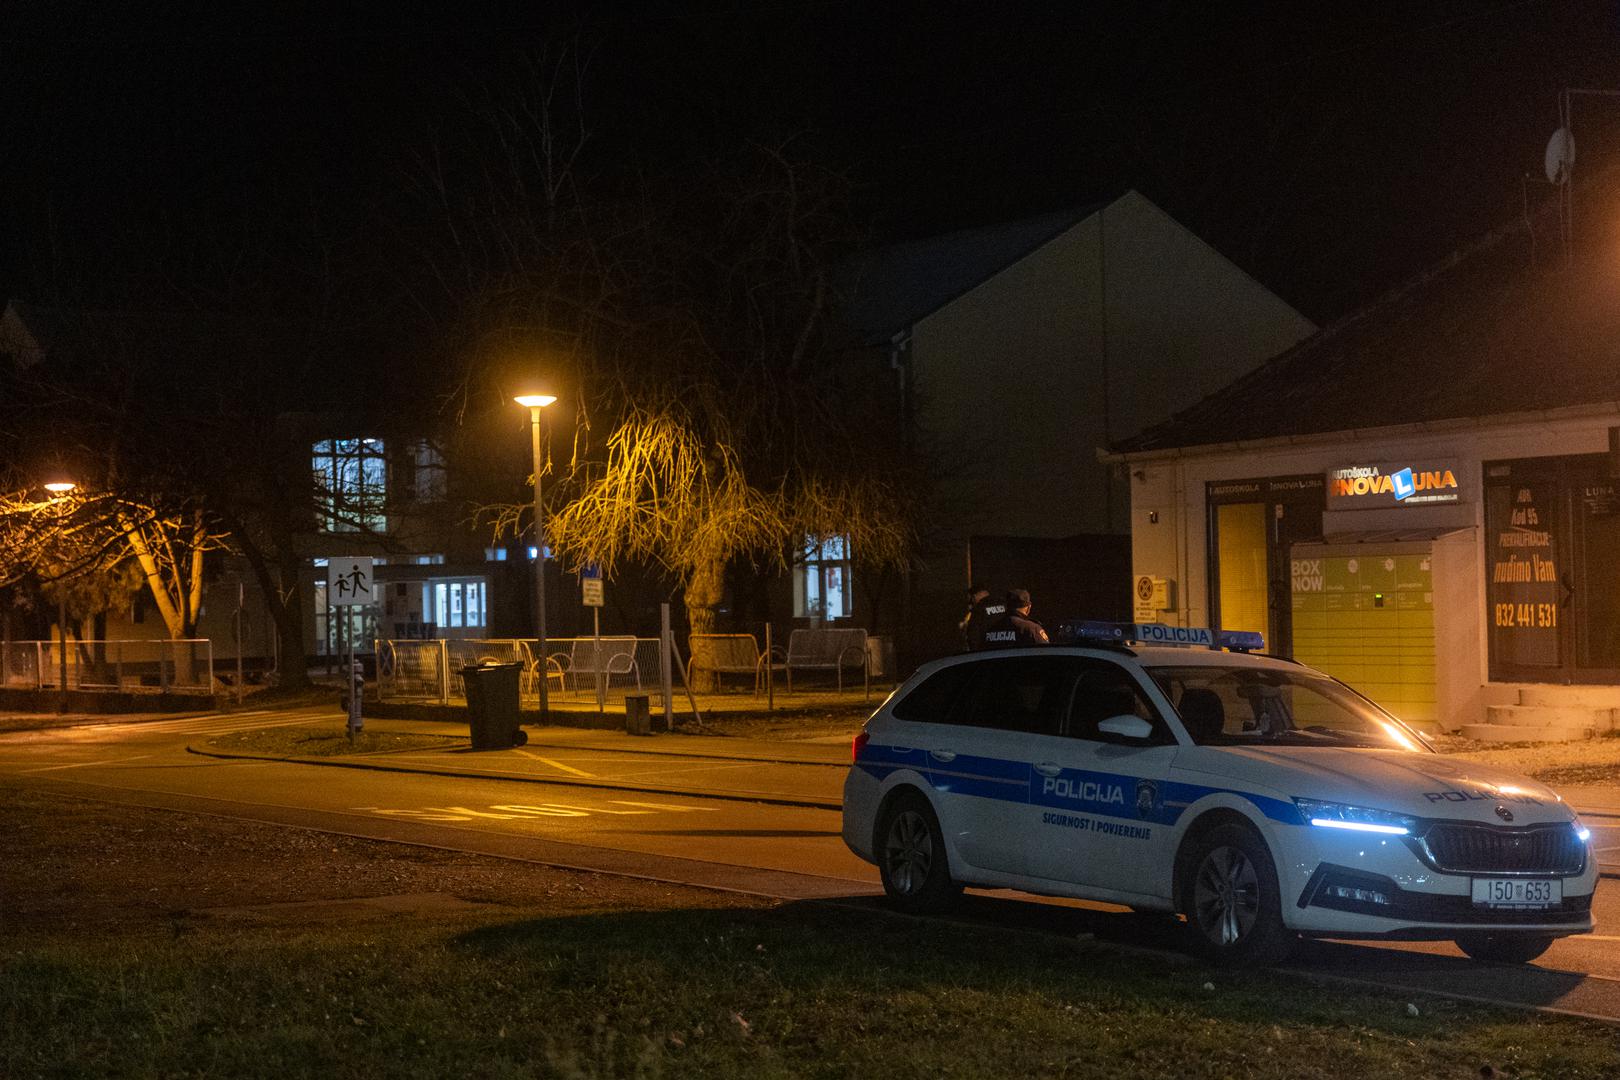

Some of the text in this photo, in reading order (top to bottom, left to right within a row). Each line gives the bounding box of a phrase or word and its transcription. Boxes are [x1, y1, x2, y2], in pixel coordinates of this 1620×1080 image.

[1292, 559, 1321, 576] BOX
[1533, 554, 1557, 582] Vam
[1292, 575, 1323, 592] NOW
[1517, 604, 1535, 627] 441
[1539, 604, 1557, 628] 531
[985, 631, 1017, 642] POLICIJA
[1142, 626, 1210, 643] POLICIJA
[1043, 777, 1124, 805] POLICIJA
[1042, 812, 1090, 830] SIGURNOST
[1096, 820, 1152, 840] POVJERENJE
[1488, 881, 1551, 901] 150 653
